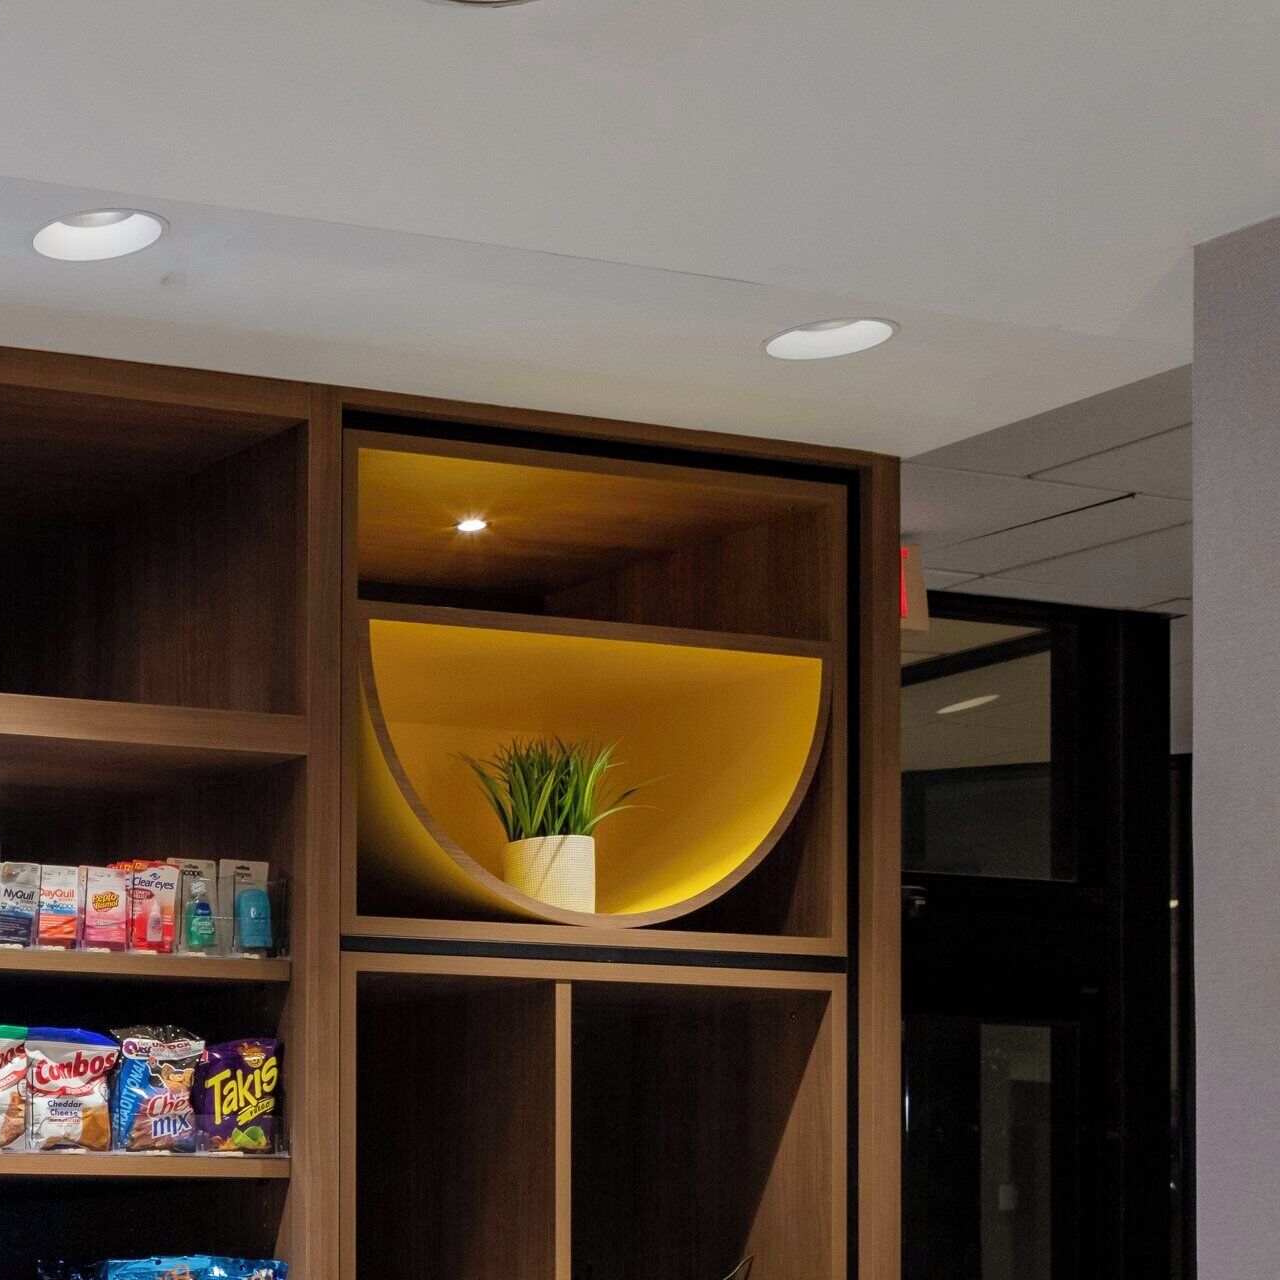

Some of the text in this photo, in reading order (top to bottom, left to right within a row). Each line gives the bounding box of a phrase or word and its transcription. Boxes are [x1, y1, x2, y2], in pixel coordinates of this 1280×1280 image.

[132, 877, 174, 890] Clear eyes
[4, 888, 34, 900] NyQuil
[48, 1100, 83, 1108] Cheddar
[250, 1102, 270, 1117] FUEGO
[50, 1109, 78, 1117] Cheese
[153, 1113, 191, 1138] mix
